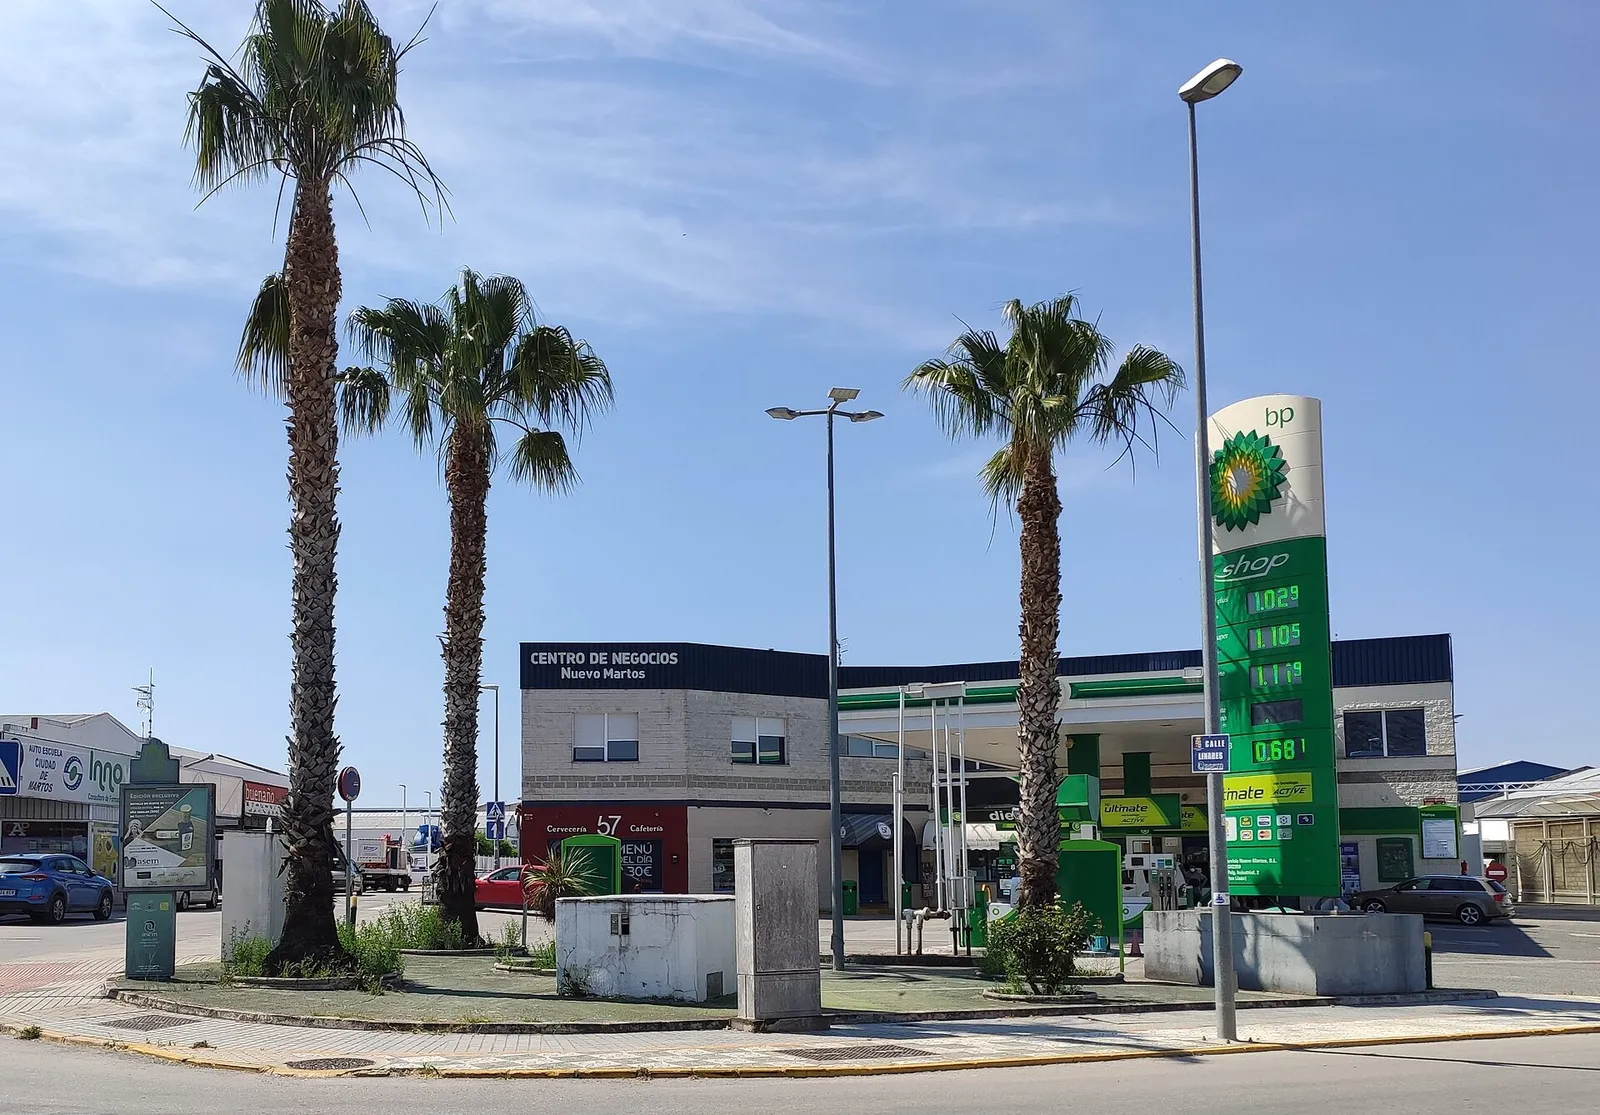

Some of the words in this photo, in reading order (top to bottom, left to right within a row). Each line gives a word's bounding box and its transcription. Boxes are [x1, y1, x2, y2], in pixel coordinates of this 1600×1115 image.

[1266, 407, 1294, 428] bp
[1217, 553, 1290, 580] shop
[1216, 633, 1229, 641] uper
[530, 652, 586, 665] CENTRO
[590, 652, 608, 664] DE
[612, 652, 679, 665] NEGOCIOS
[561, 667, 601, 679] Nuevo
[603, 668, 646, 679] Martos
[1205, 740, 1225, 748] CALLE
[29, 745, 41, 754] AUTO
[42, 746, 63, 757] ESCUELA
[1198, 752, 1224, 760] LINARES
[34, 758, 57, 770] CIUDAD
[39, 771, 48, 780] DE
[28, 781, 53, 793] MARTOS
[245, 783, 275, 803] buenaño
[1224, 786, 1264, 801] imate
[1273, 787, 1307, 795] ACTIVE
[1104, 804, 1148, 813] ultimate
[1181, 811, 1195, 819] te
[546, 825, 587, 833] Cervecería
[630, 824, 664, 832] Cafetería
[137, 858, 159, 866] asem
[636, 854, 652, 864] DÍA
